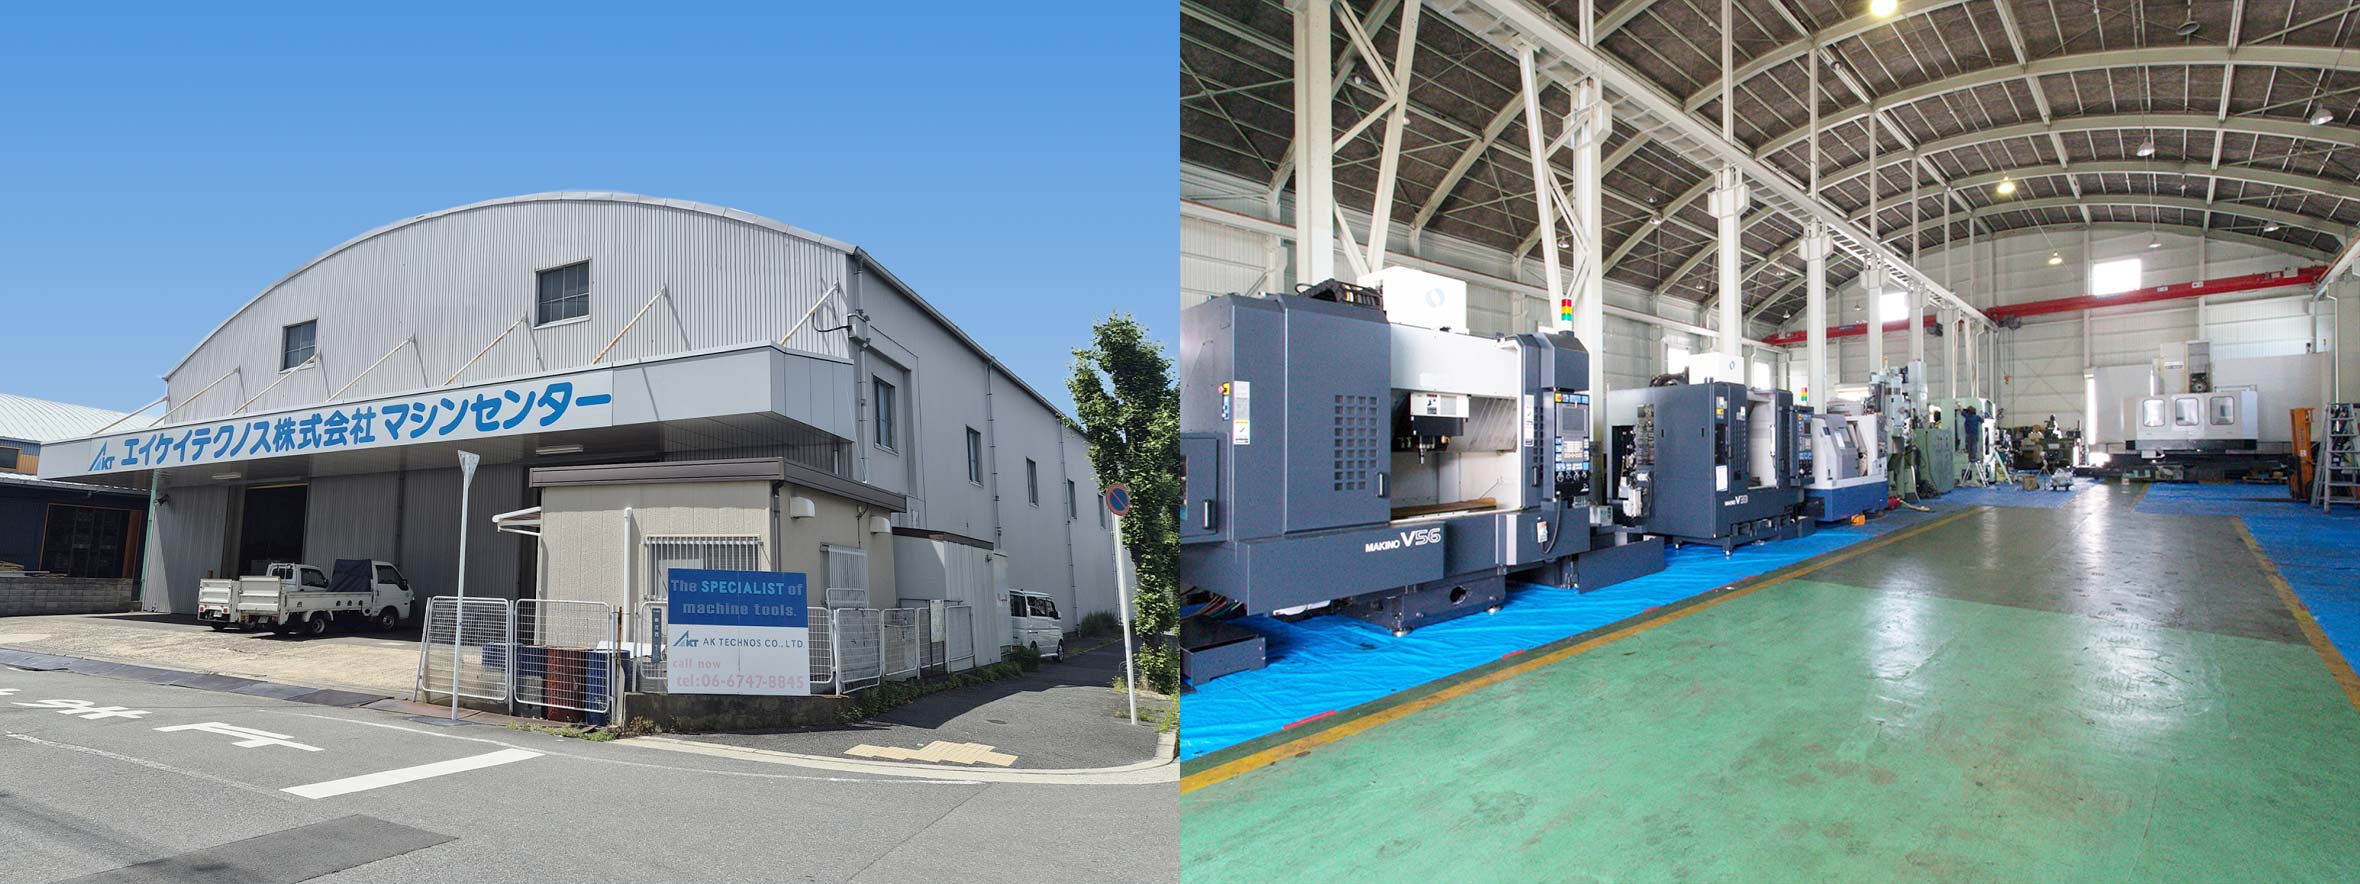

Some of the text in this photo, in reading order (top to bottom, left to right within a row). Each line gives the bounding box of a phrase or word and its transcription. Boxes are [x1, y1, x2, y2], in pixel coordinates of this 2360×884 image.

[382, 381, 612, 439] マシンセンター
[1365, 527, 1441, 553] MAKINO V56
[671, 580, 803, 596] The SPECIALIST of
[682, 603, 797, 617] machine tools.
[703, 638, 715, 647] AK
[719, 638, 762, 648] TECHNOS
[673, 659, 721, 669] call now
